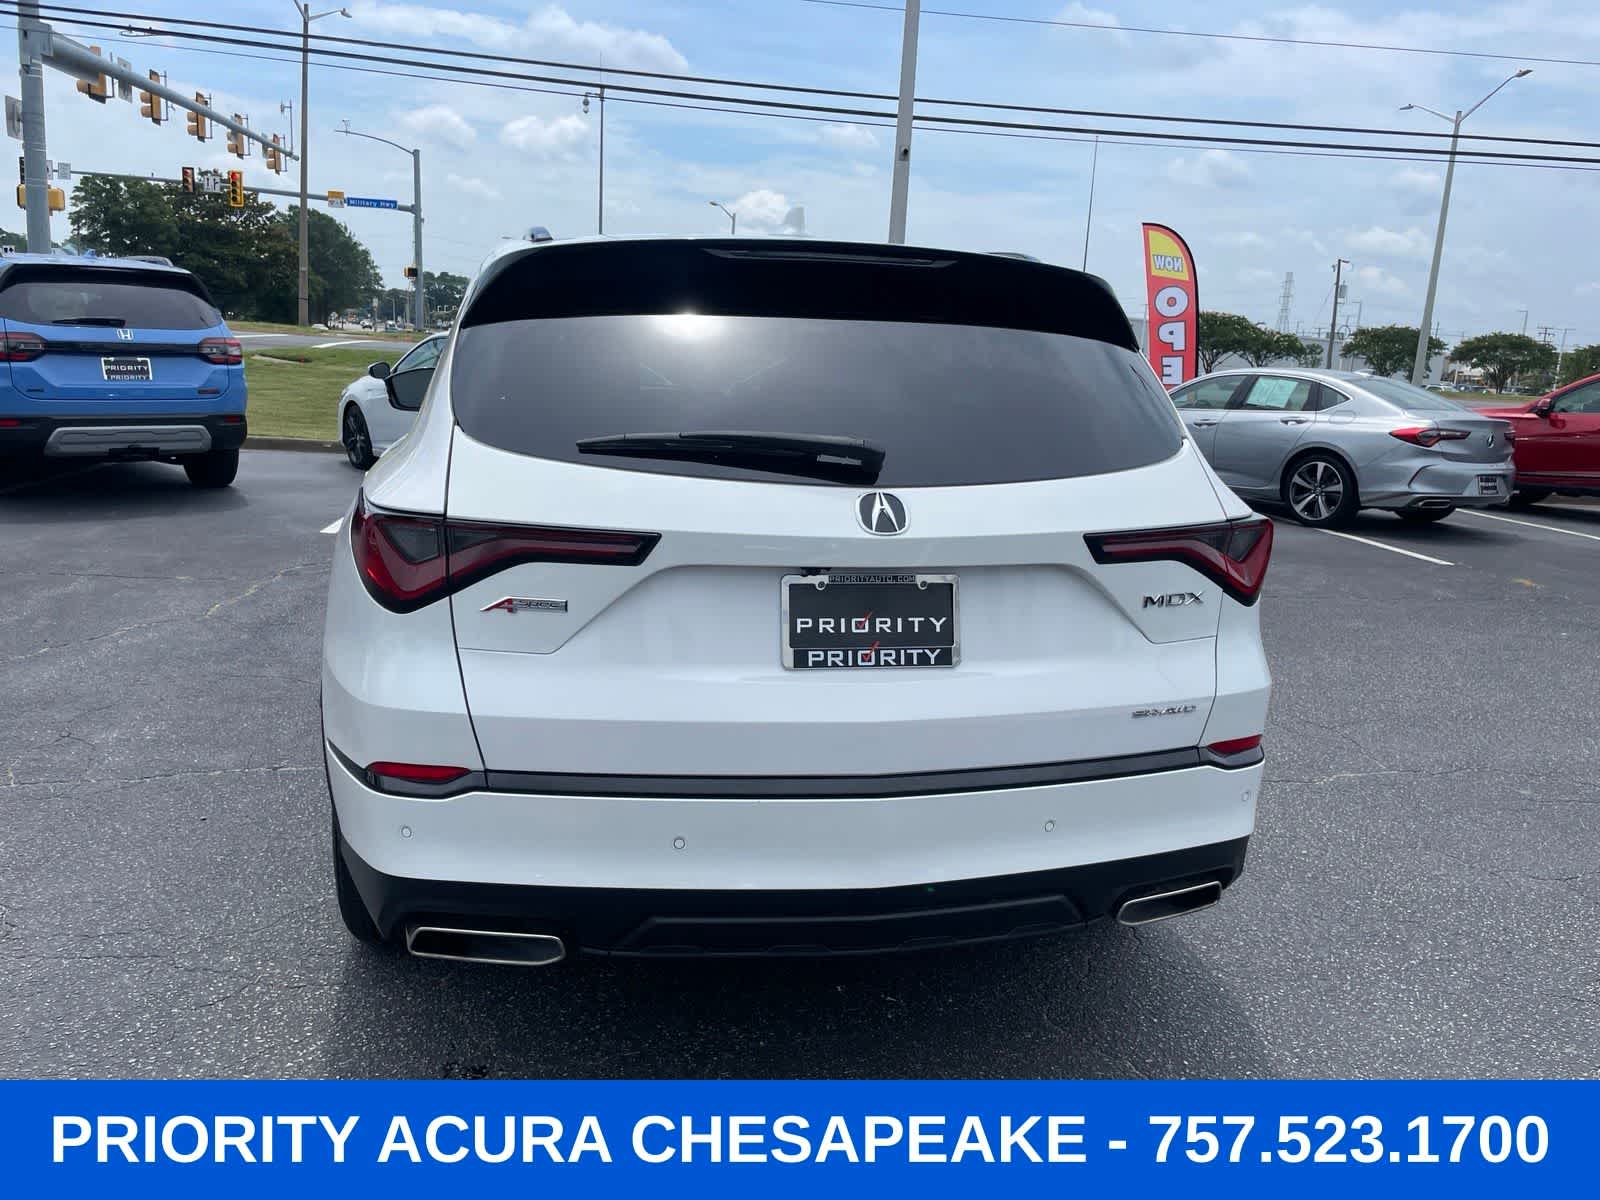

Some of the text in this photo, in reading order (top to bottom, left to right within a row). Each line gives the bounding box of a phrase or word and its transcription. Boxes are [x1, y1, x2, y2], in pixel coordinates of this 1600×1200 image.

[349, 199, 377, 208] Military
[380, 200, 395, 209] Hwy
[829, 575, 917, 584] PRIORITYAUTO.COM
[1143, 591, 1206, 608] MDX
[796, 616, 947, 634] PRIORITY
[808, 648, 942, 667] PRIORITY
